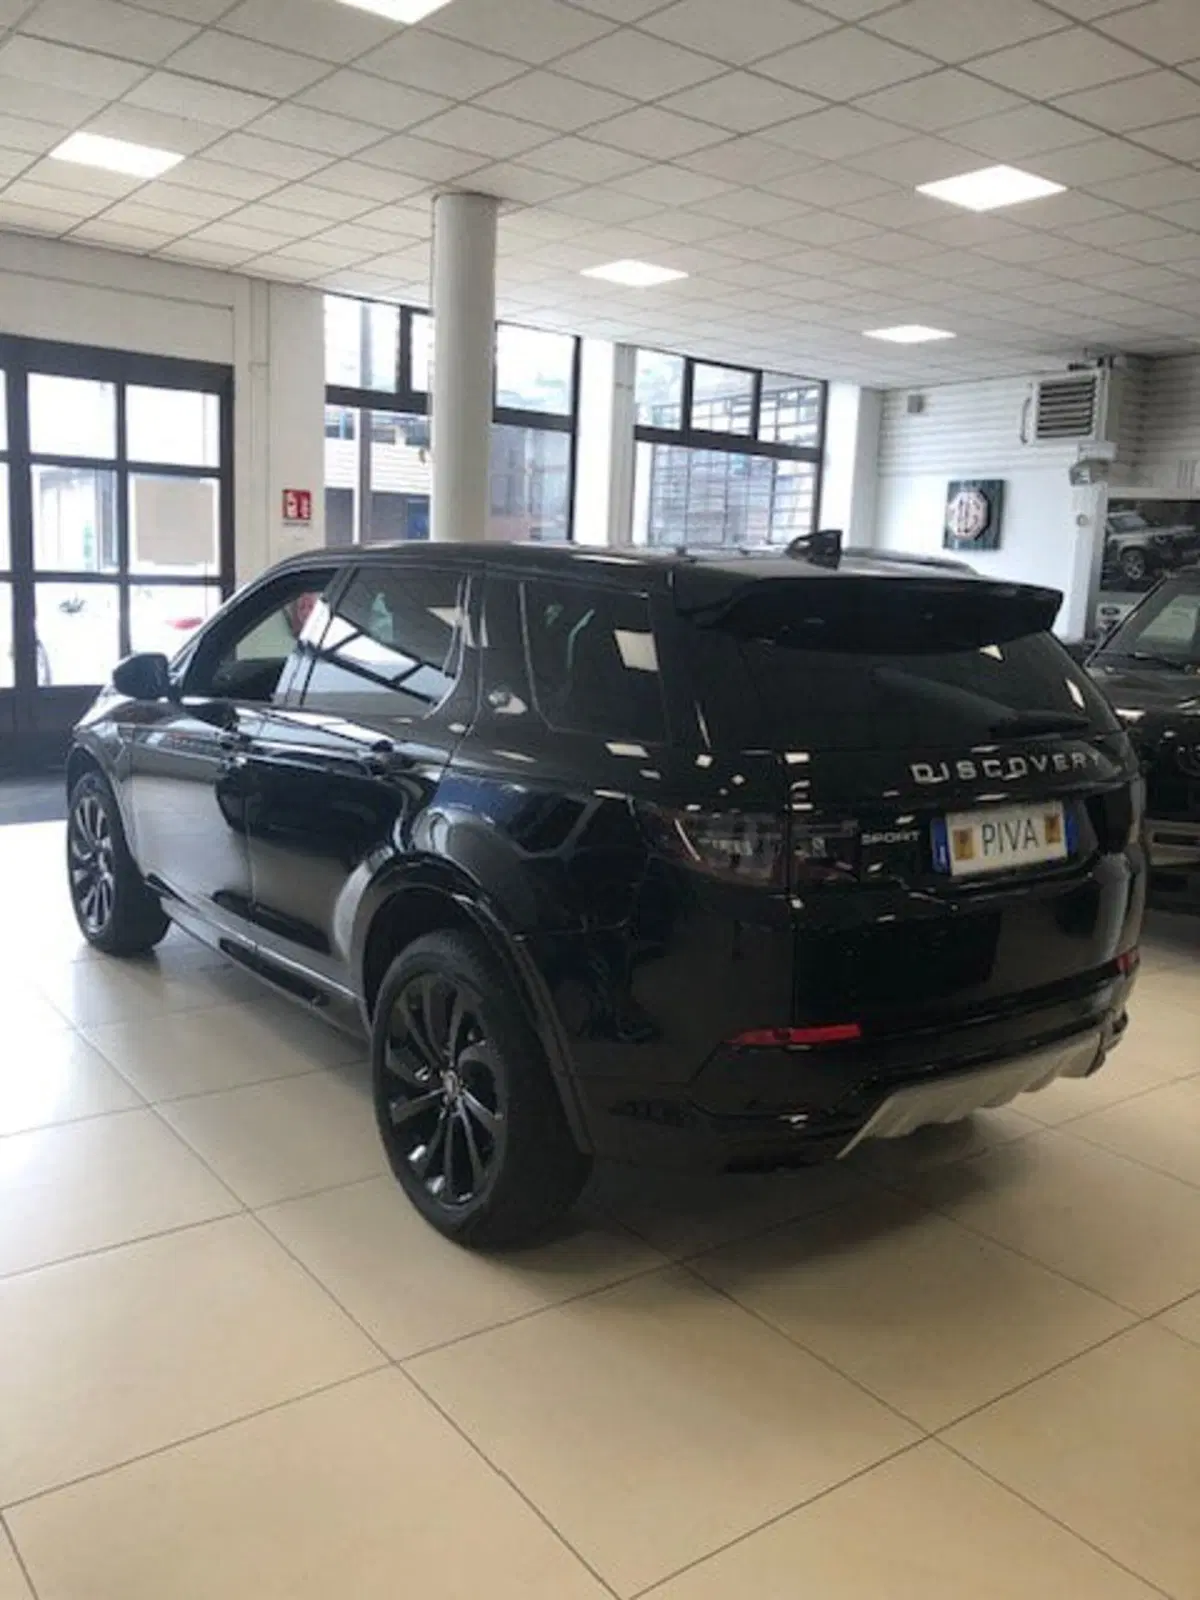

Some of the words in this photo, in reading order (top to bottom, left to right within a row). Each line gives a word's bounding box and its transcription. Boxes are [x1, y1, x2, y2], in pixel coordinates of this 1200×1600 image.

[910, 752, 1100, 782] DISCOVERY
[861, 831, 920, 846] SPORT
[981, 818, 1039, 856] PIVA
